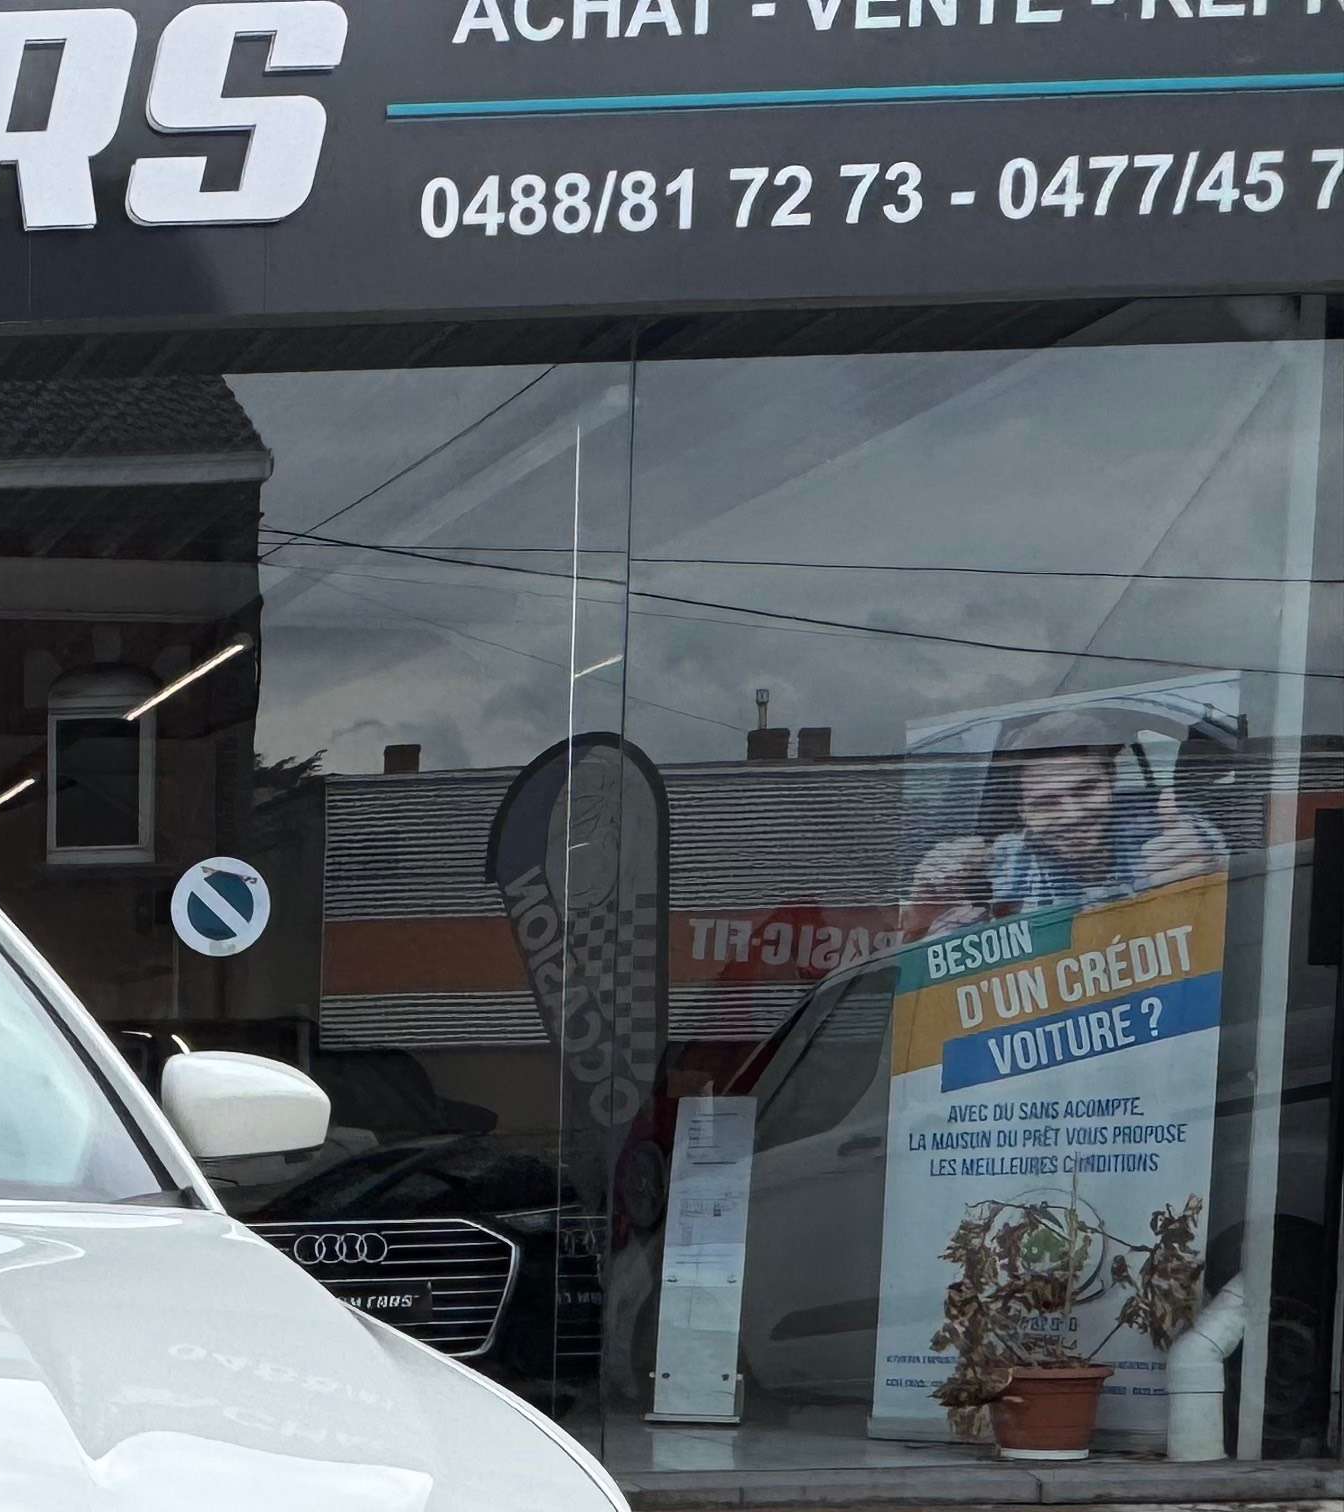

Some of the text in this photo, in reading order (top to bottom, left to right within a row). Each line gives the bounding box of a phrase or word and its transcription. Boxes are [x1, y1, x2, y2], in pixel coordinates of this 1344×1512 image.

[420, 166, 695, 239] 0488/81
[729, 164, 813, 228] 72
[839, 161, 923, 224] 73
[999, 150, 1285, 220] 0477/45
[927, 920, 1033, 979] BESOIN
[956, 925, 1193, 1029] D'UN CRÉDIT
[988, 996, 1163, 1074] VOITURE ?
[909, 1123, 1188, 1151] LA MAISON DU PRÊT VOUS PROPOSE
[947, 1104, 988, 1123] AVEC
[1018, 1100, 1060, 1120] SANS
[1064, 1097, 1145, 1119] ACOMPTE
[930, 1158, 957, 1177] LES
[961, 1155, 1058, 1177] MEILLEURES
